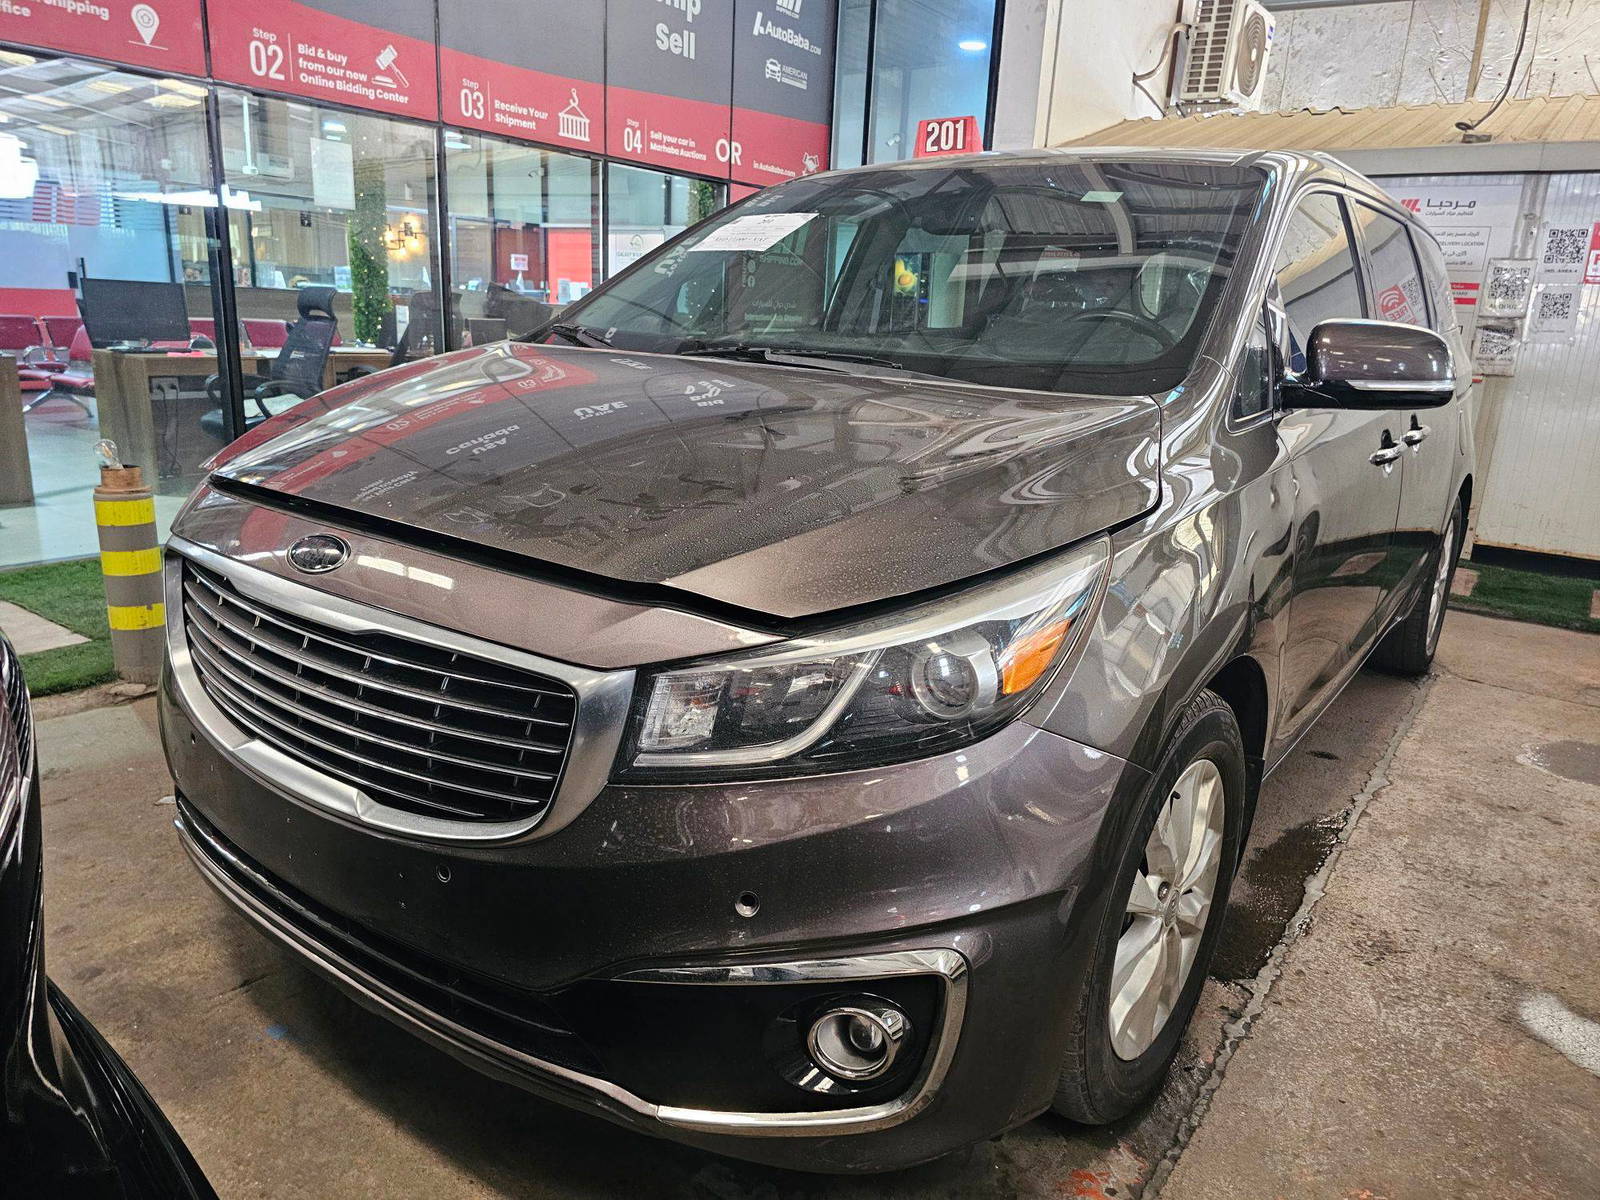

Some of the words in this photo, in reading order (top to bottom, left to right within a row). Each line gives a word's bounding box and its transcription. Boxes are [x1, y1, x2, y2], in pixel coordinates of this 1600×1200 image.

[0, 0, 31, 17] fice
[252, 27, 277, 43] Step
[655, 22, 696, 60] Sell
[249, 40, 285, 81] 02
[297, 43, 316, 57] Bid
[317, 48, 326, 59] &
[326, 50, 348, 66] buy
[299, 57, 326, 73] from
[327, 66, 344, 77] our
[345, 70, 368, 82] new
[299, 73, 335, 89] Online
[335, 80, 376, 100] Bidding
[376, 89, 409, 104] Center
[462, 78, 479, 90] Step
[460, 89, 485, 120] 03
[494, 99, 529, 115] Receive
[528, 107, 549, 120] Your
[494, 112, 537, 130] Shipment
[626, 118, 640, 128] Step
[624, 127, 643, 154] 04
[650, 130, 662, 141] Sell
[662, 134, 678, 144] your
[678, 138, 688, 146] car
[688, 138, 696, 148] in
[926, 119, 965, 152] 201
[650, 141, 680, 155] Marhaba
[680, 148, 707, 161] Auctions
[715, 138, 743, 166] OR
[1426, 198, 1477, 210] مرحبا
